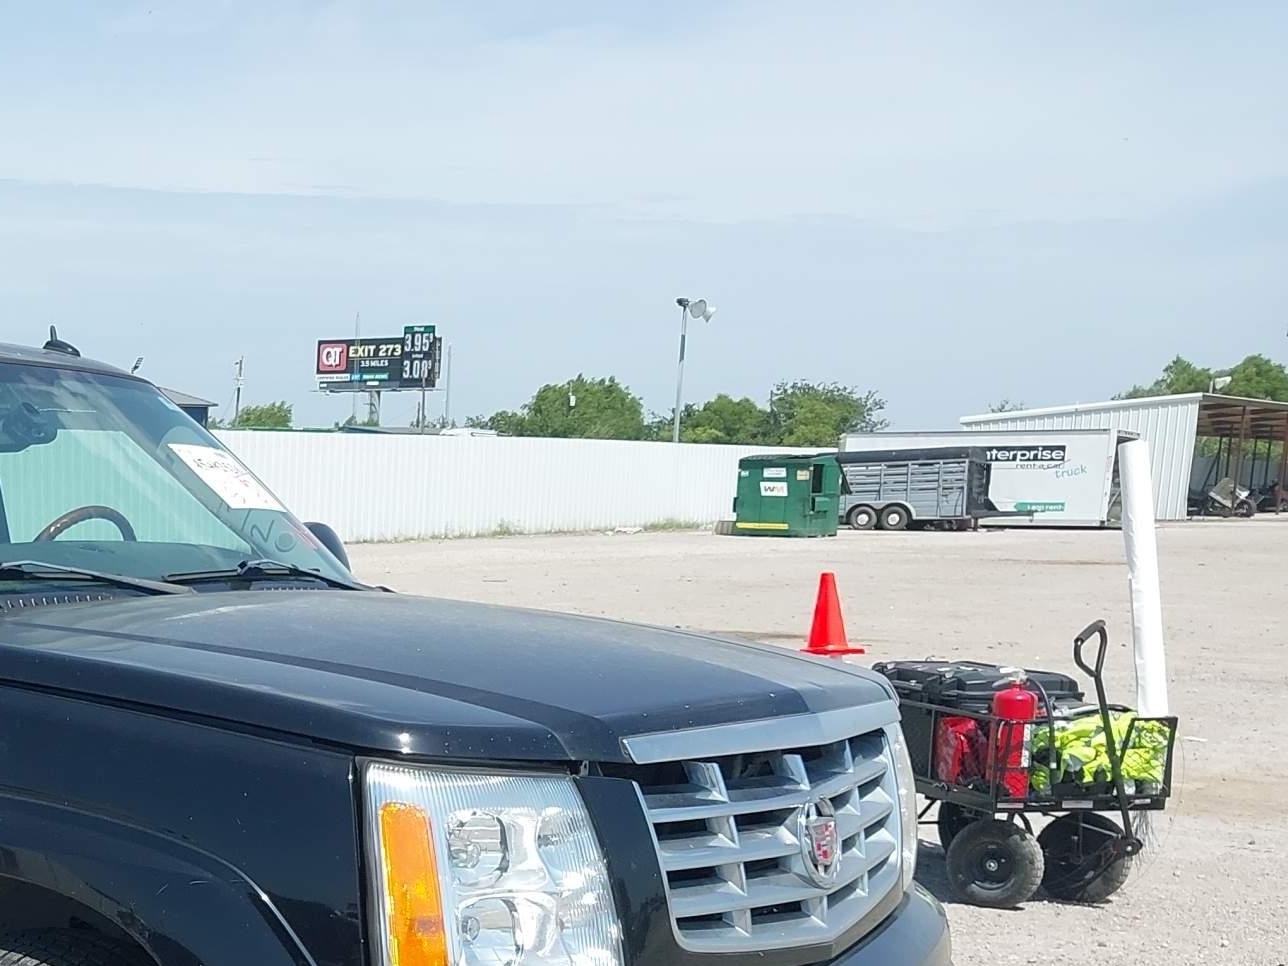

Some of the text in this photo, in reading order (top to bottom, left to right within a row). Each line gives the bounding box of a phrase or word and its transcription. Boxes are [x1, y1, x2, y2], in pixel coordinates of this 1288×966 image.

[322, 347, 343, 368] QT
[348, 344, 402, 358] EXIT 273
[370, 359, 389, 367] MILES
[1055, 464, 1088, 479] truck
